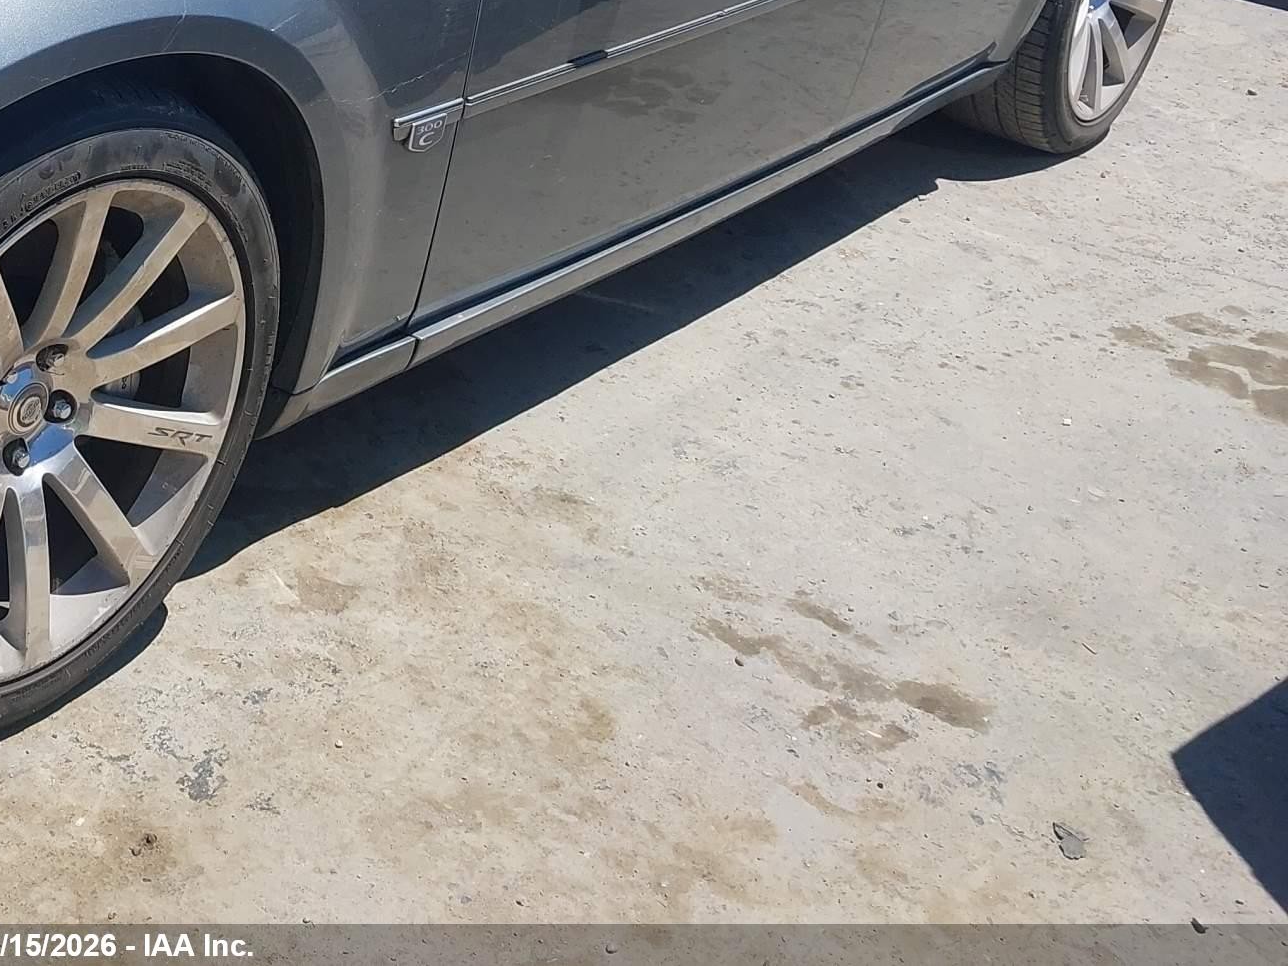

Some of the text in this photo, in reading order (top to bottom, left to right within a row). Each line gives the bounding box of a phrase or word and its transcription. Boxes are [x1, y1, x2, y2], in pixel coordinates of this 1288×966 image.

[416, 120, 443, 135] 300
[419, 132, 435, 145] C
[147, 426, 213, 447] SRT
